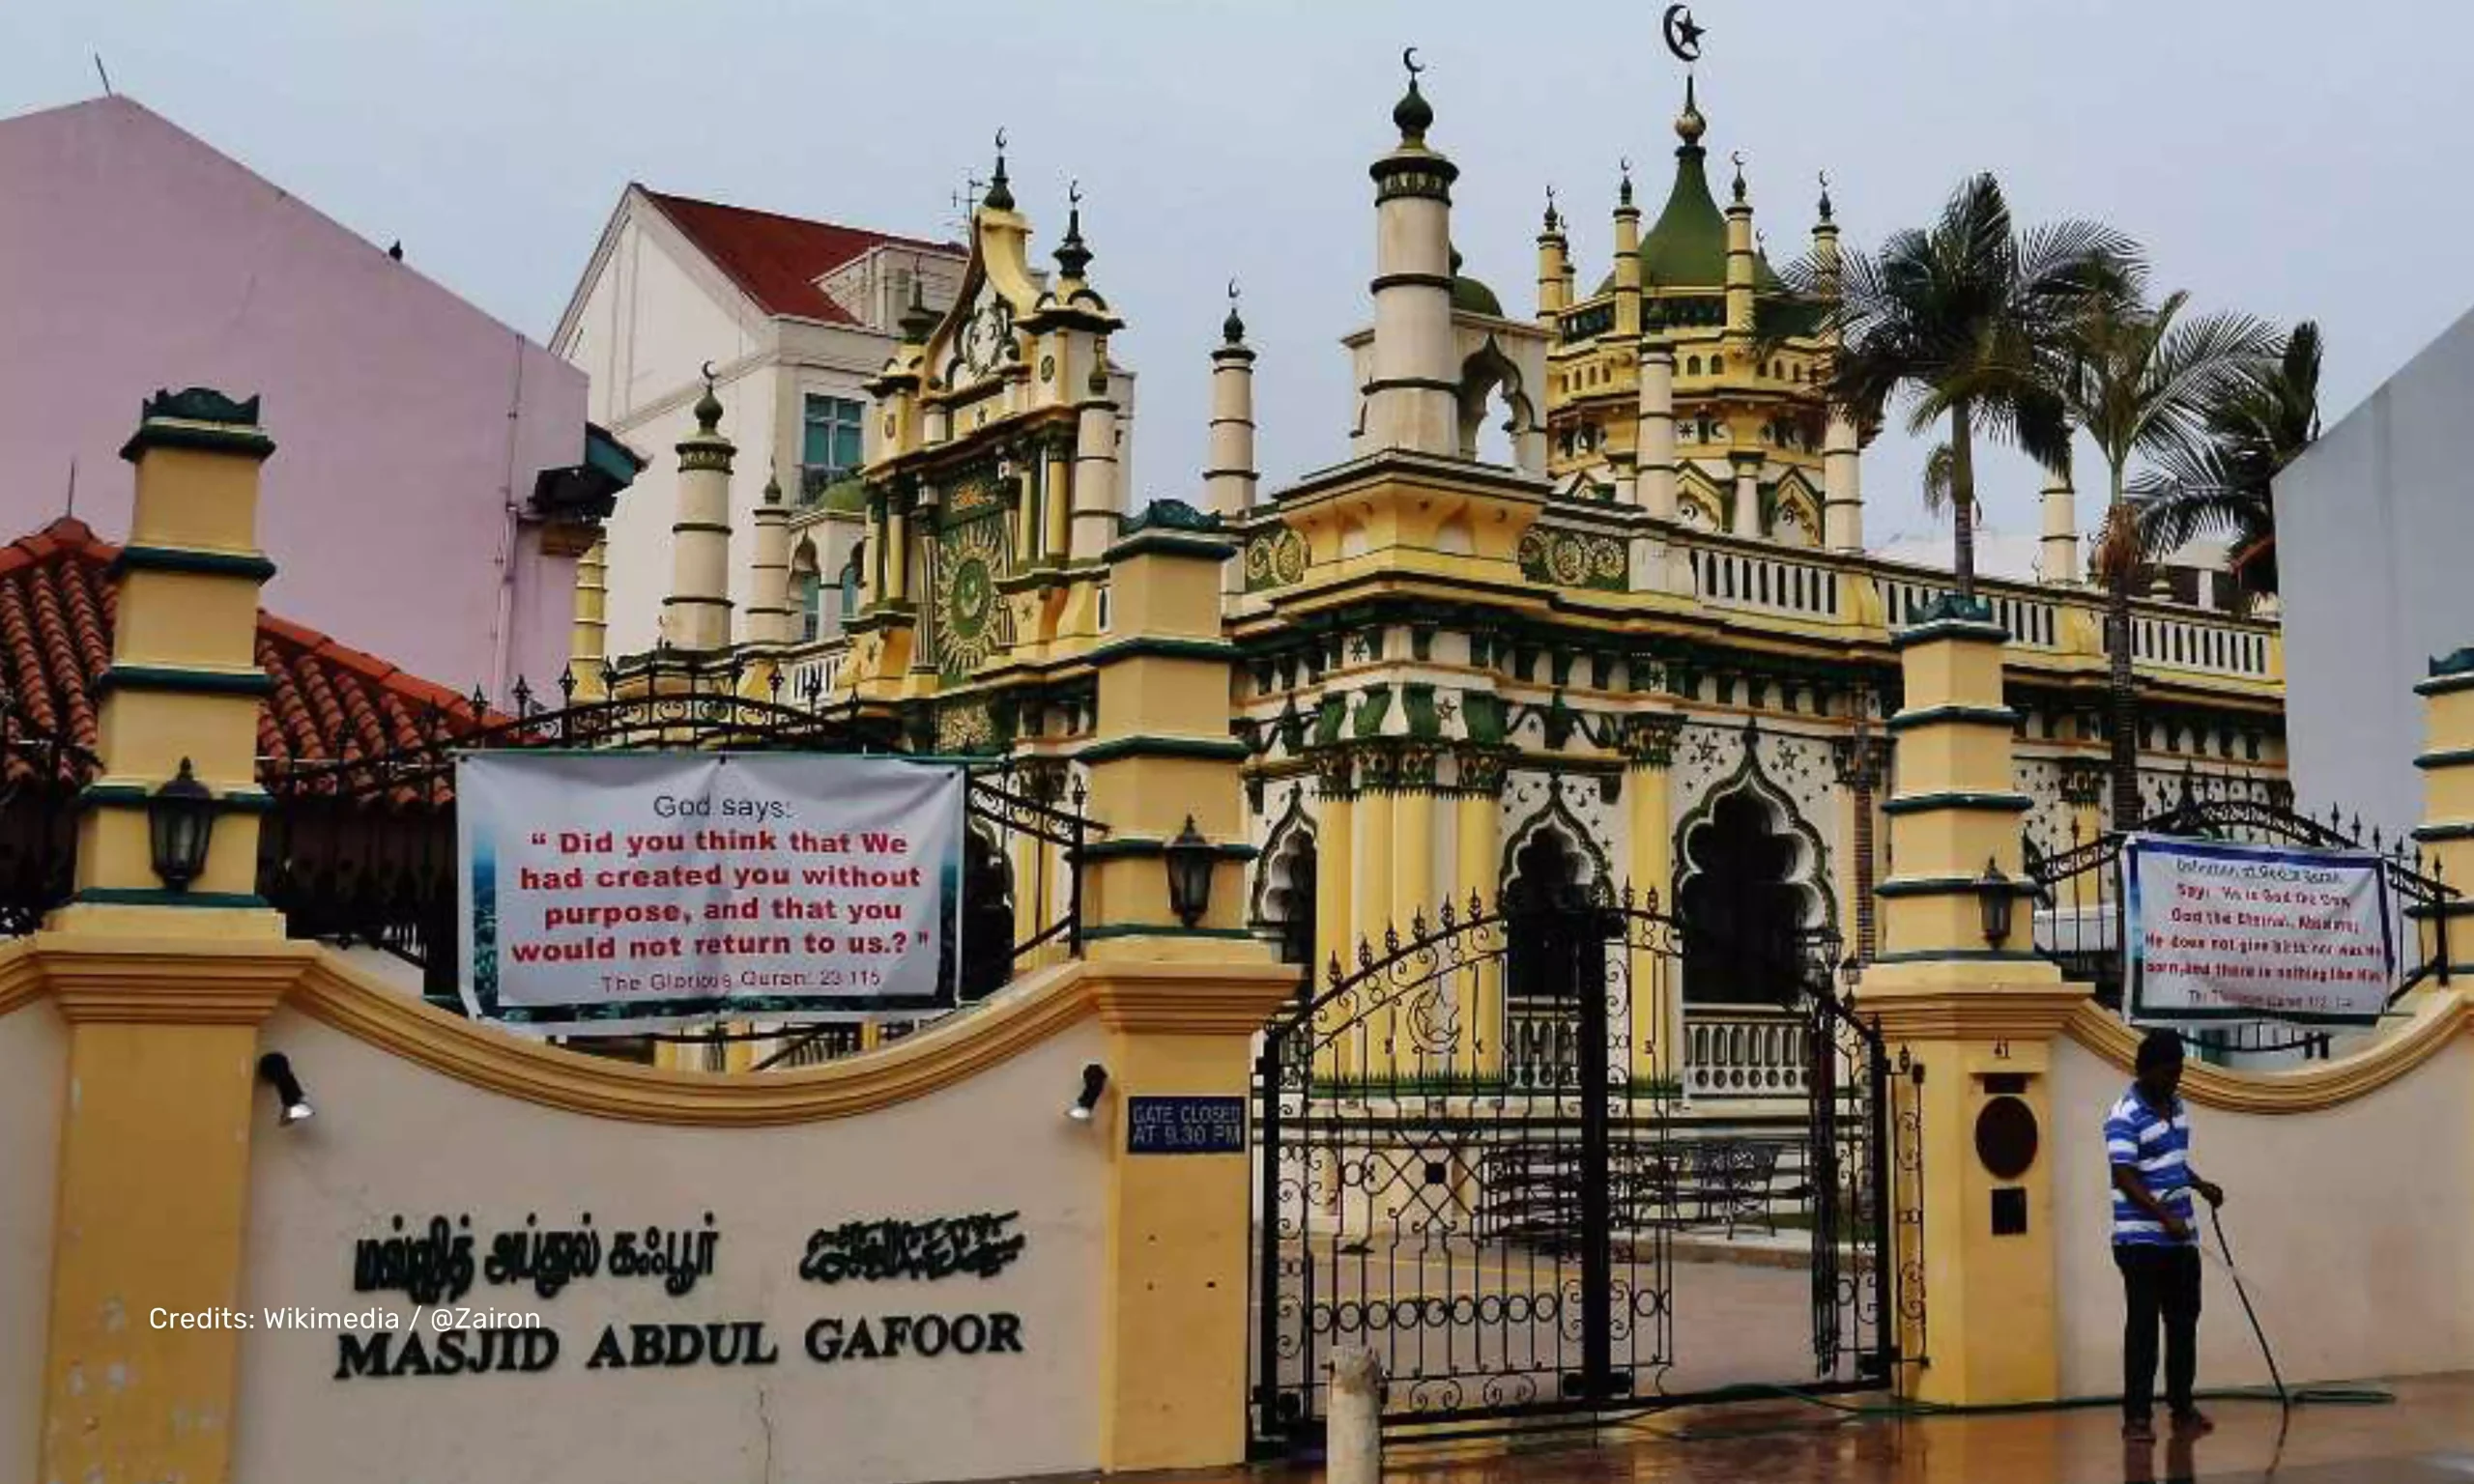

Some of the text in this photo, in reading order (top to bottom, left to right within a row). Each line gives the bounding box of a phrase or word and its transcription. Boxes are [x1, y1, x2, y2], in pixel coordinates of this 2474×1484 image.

[654, 793, 792, 822] God says:
[560, 831, 614, 854] Did
[628, 835, 685, 858] you
[696, 828, 777, 851] think
[790, 831, 850, 853] that
[862, 833, 907, 854] We
[521, 864, 920, 891] had created you without
[545, 897, 901, 930] purpose, and that you
[511, 936, 616, 962] would
[630, 936, 681, 959] not
[695, 933, 791, 956] return
[804, 932, 835, 955] to
[601, 975, 642, 993] The
[1133, 1104, 1241, 1124] GATE CLOSED
[1133, 1125, 1157, 1143] AT
[1214, 1124, 1242, 1145] PM
[333, 1311, 1024, 1380] MASJID ABDUL GAFOOR
